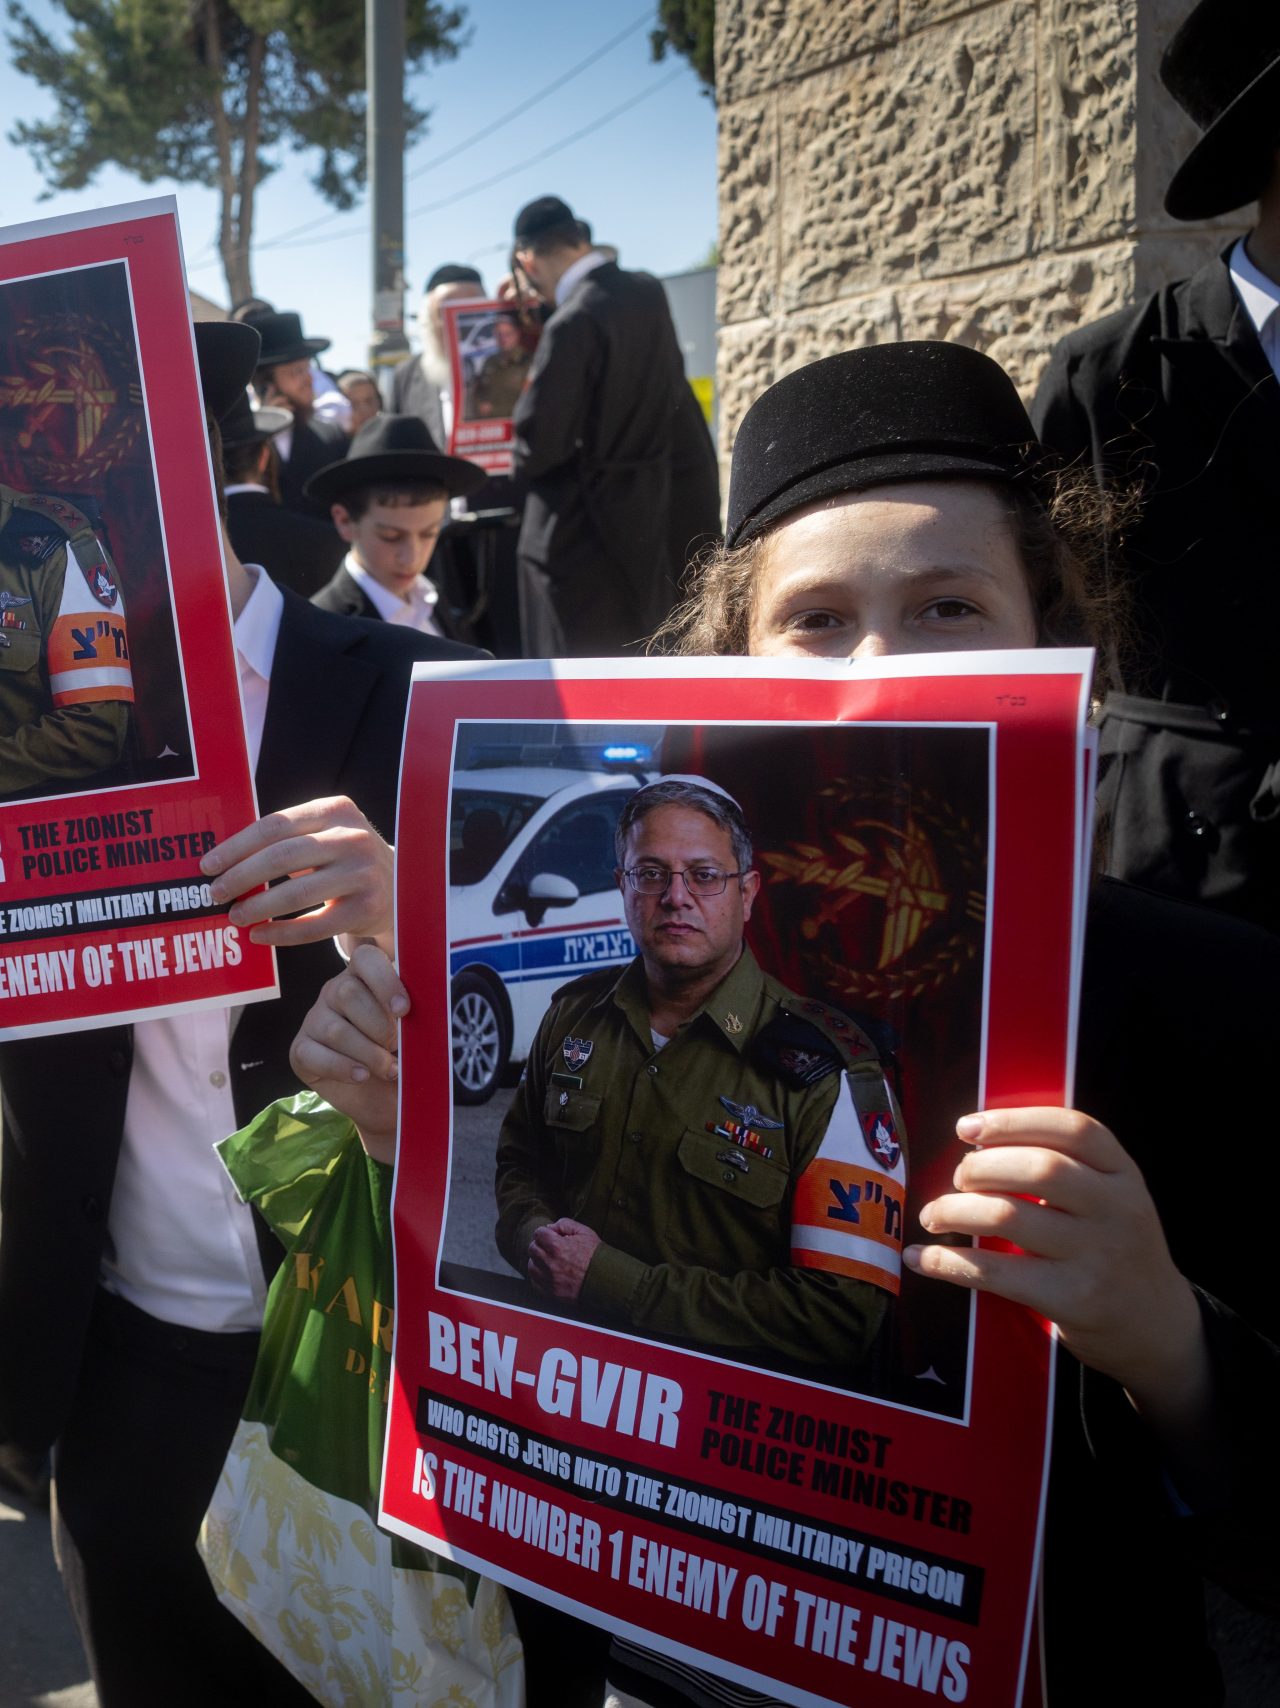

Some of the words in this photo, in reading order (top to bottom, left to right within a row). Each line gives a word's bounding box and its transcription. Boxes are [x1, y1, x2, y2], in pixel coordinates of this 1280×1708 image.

[71, 620, 129, 661] מ"צ
[17, 822, 61, 850] THE
[63, 808, 154, 844] ZIONIST
[22, 847, 101, 880] POLICE
[105, 830, 216, 869] MINISTER
[7, 901, 74, 932] ZIONIST
[75, 890, 155, 924] MILITARY
[157, 883, 224, 914] PRISO
[81, 943, 115, 988] OF
[117, 936, 170, 983] THE
[173, 925, 243, 975] JEWS
[563, 932, 636, 963] הצבאית
[827, 1178, 901, 1241] מ"צ
[428, 1310, 683, 1449] BEN-GVIR
[707, 1389, 762, 1434] THE
[765, 1406, 893, 1470] ZIONIST
[427, 1398, 464, 1437] WHO
[466, 1414, 520, 1460] CASTS
[522, 1438, 571, 1481] JEWS
[573, 1456, 622, 1497] INTO
[625, 1471, 663, 1511] THE
[664, 1484, 752, 1539] ZIONIST
[752, 1511, 865, 1574] MILITARY
[866, 1545, 966, 1607] PRISON
[699, 1427, 806, 1487] POLICE
[811, 1457, 973, 1535] MINISTER
[412, 1447, 438, 1500] IS
[442, 1458, 487, 1523] THE
[489, 1479, 602, 1573] NUMBER
[608, 1530, 624, 1580] 1
[628, 1535, 738, 1620] ENEMY
[741, 1573, 788, 1638] OF
[793, 1588, 862, 1666] THE
[863, 1614, 971, 1704] JEWS
